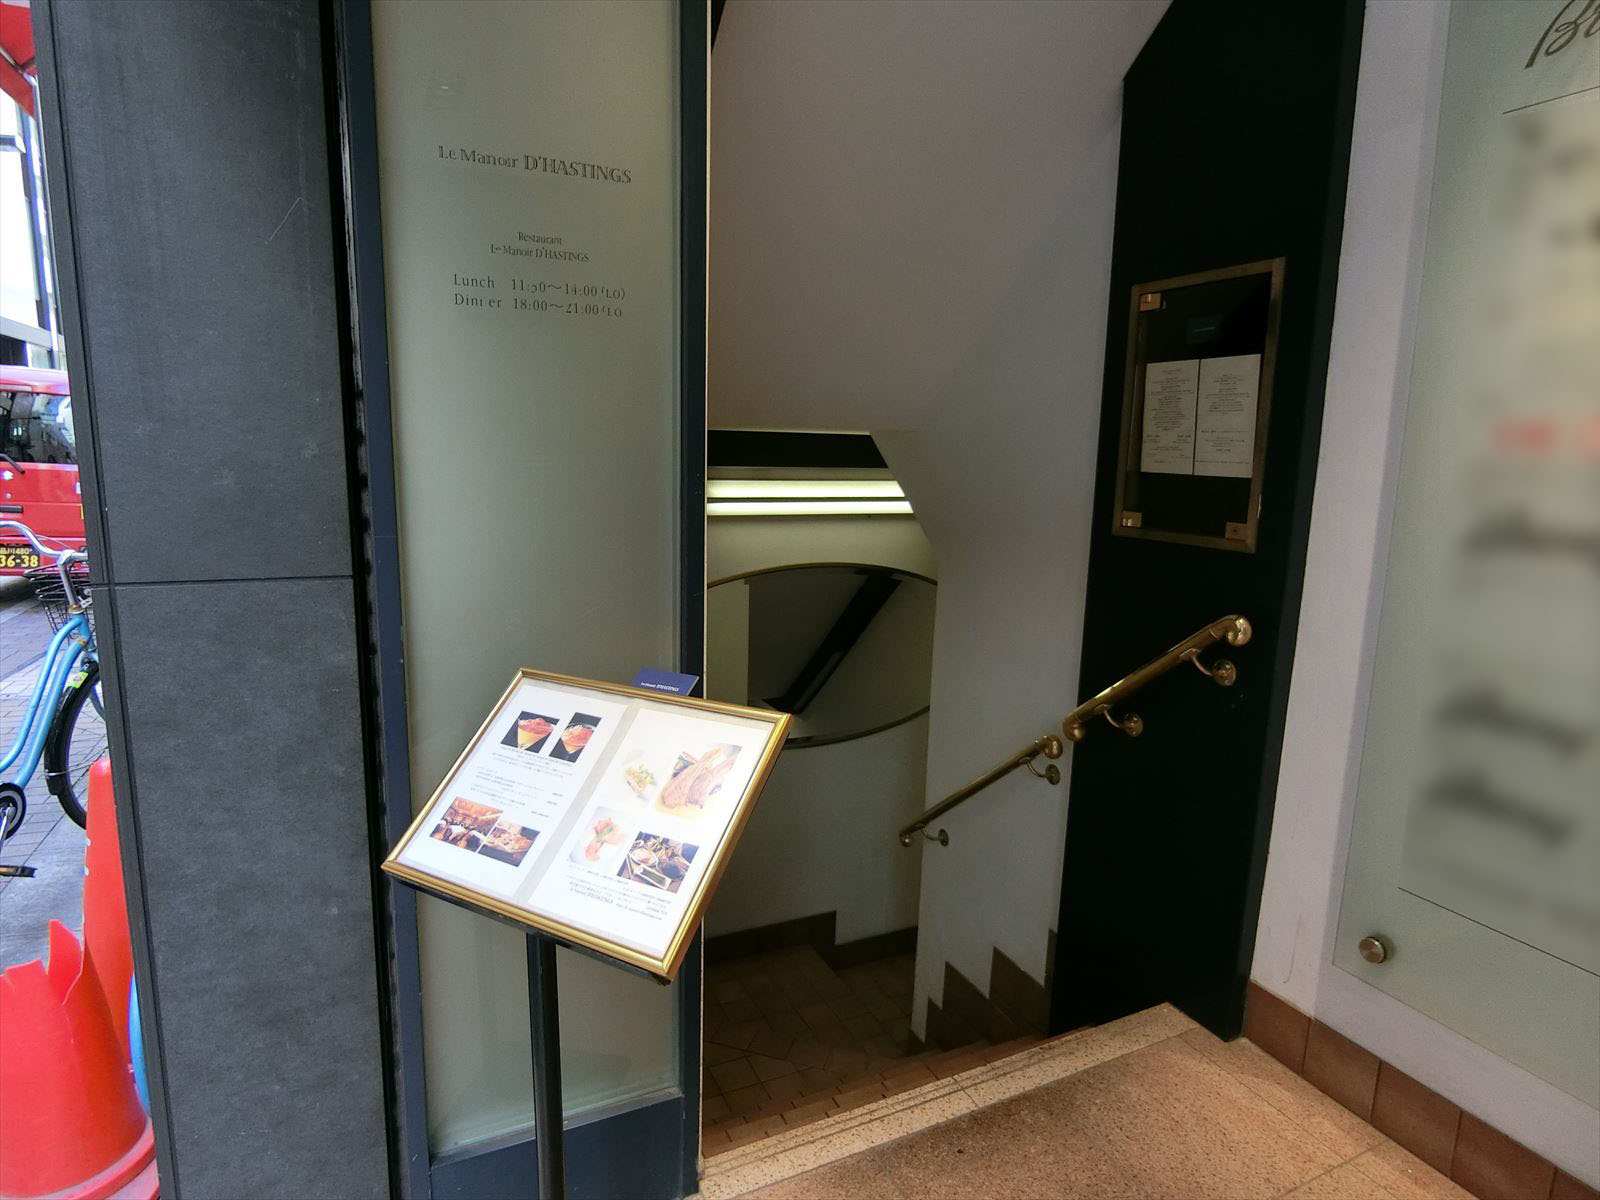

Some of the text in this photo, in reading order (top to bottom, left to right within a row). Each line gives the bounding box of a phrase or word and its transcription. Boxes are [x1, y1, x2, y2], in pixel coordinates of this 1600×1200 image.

[439, 145, 632, 184] Le Manoir D'HASTINGS
[518, 232, 562, 244] Restaurant
[535, 246, 590, 263] D'HASTINGS
[453, 273, 496, 289] Lunch
[0, 555, 39, 568] 36-38
